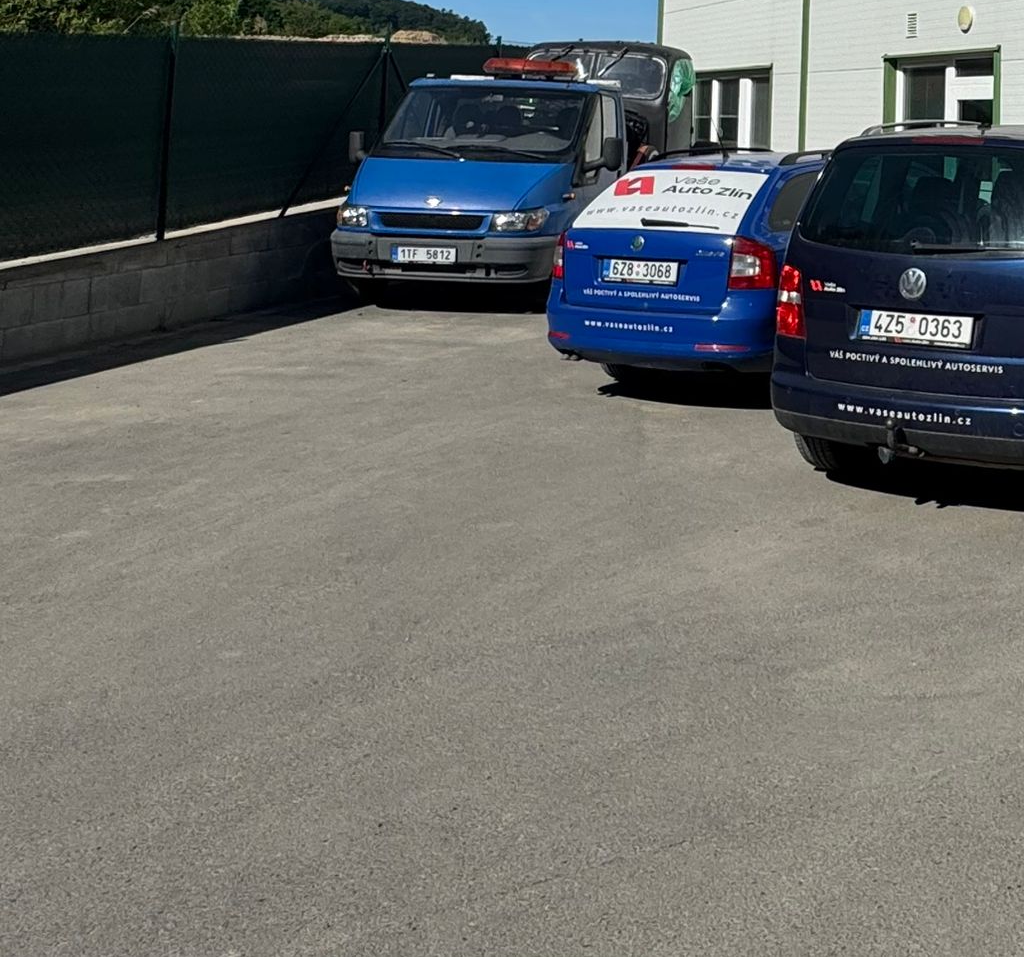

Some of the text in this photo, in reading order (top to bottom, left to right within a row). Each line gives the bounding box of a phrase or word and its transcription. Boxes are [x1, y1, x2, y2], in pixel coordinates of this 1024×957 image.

[674, 175, 721, 186] Vaše
[662, 185, 711, 196] Auto
[586, 204, 740, 220] www.vaseautozlin.cz
[401, 249, 452, 261] 1TF 5812
[612, 261, 672, 279] 6Z8 3068
[661, 293, 700, 302] AUTOSERVIS
[874, 313, 906, 334] 4Z5
[918, 316, 963, 339] 0363
[830, 349, 1004, 374] VÁŠ POCTIVÝ A SPOLEHLIVÝ AUTOSERVIS
[838, 403, 972, 426] www.vaseautozlin.cz
